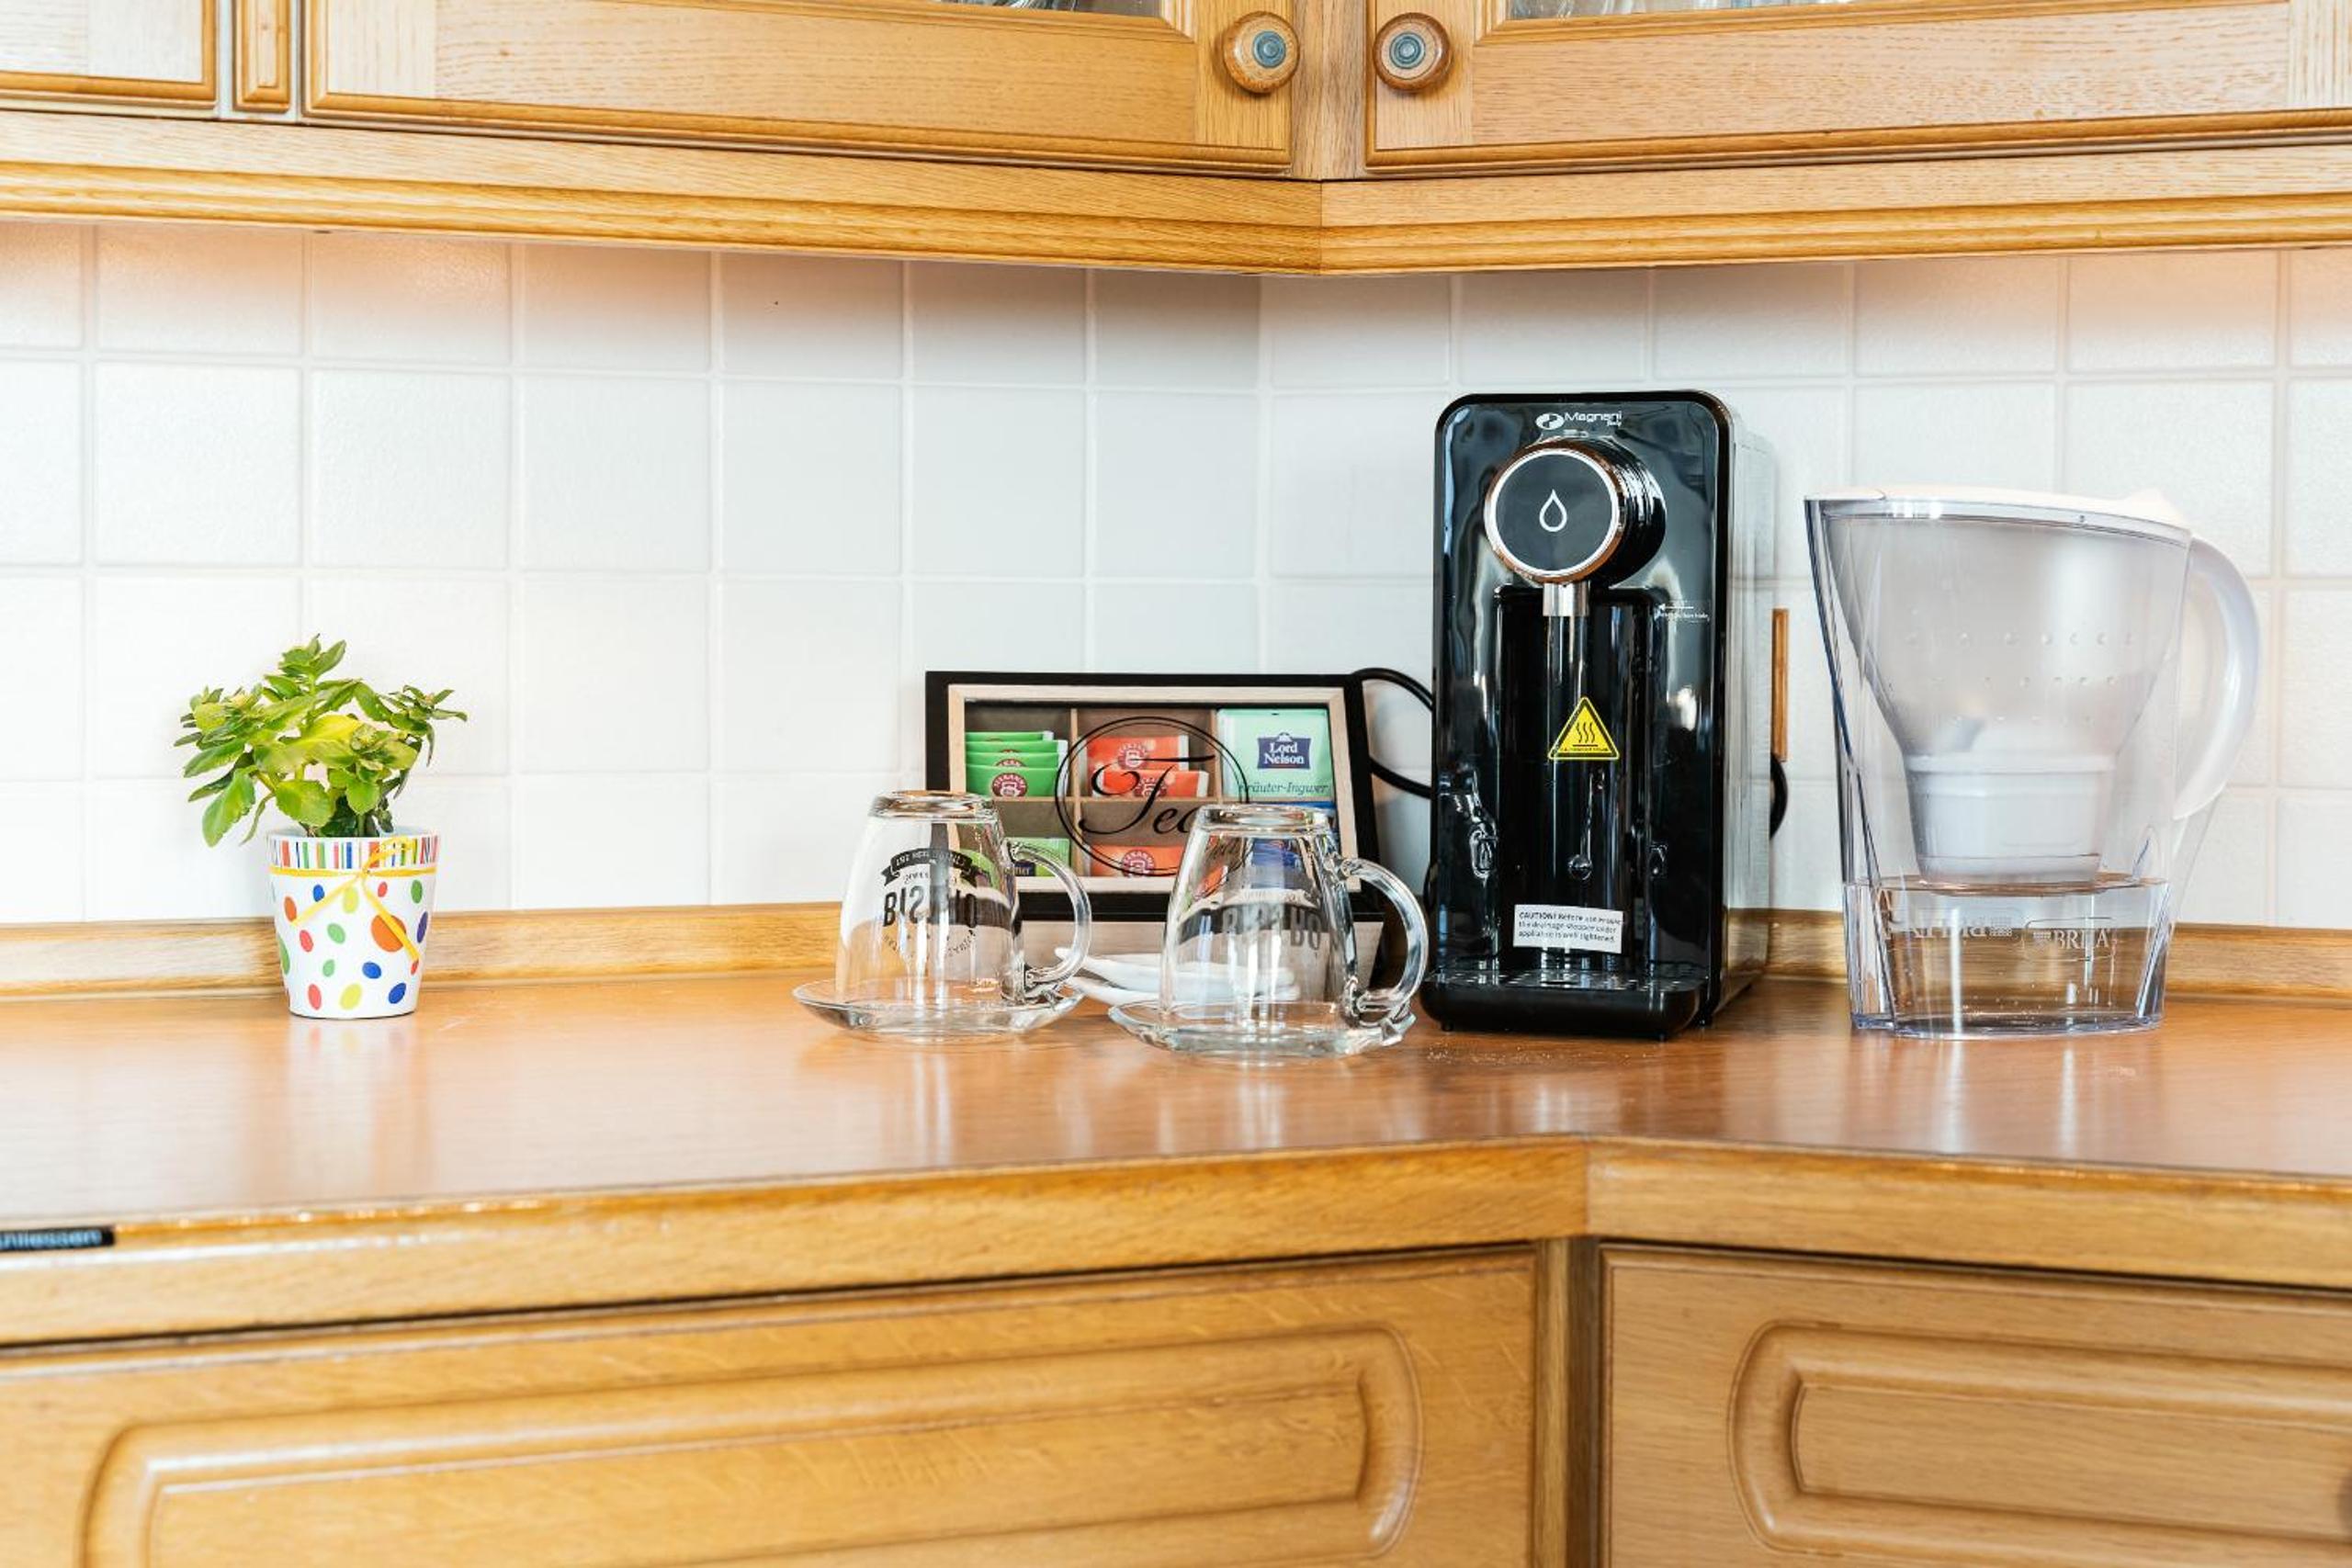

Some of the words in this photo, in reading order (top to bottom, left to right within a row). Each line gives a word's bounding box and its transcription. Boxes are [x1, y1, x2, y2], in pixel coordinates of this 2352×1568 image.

[1564, 411, 1623, 423] Magnani
[1269, 742, 1298, 753] Lord
[1263, 751, 1306, 765] Nelson
[1518, 911, 1556, 920] CAUTION!
[2052, 930, 2109, 950] BRIA
